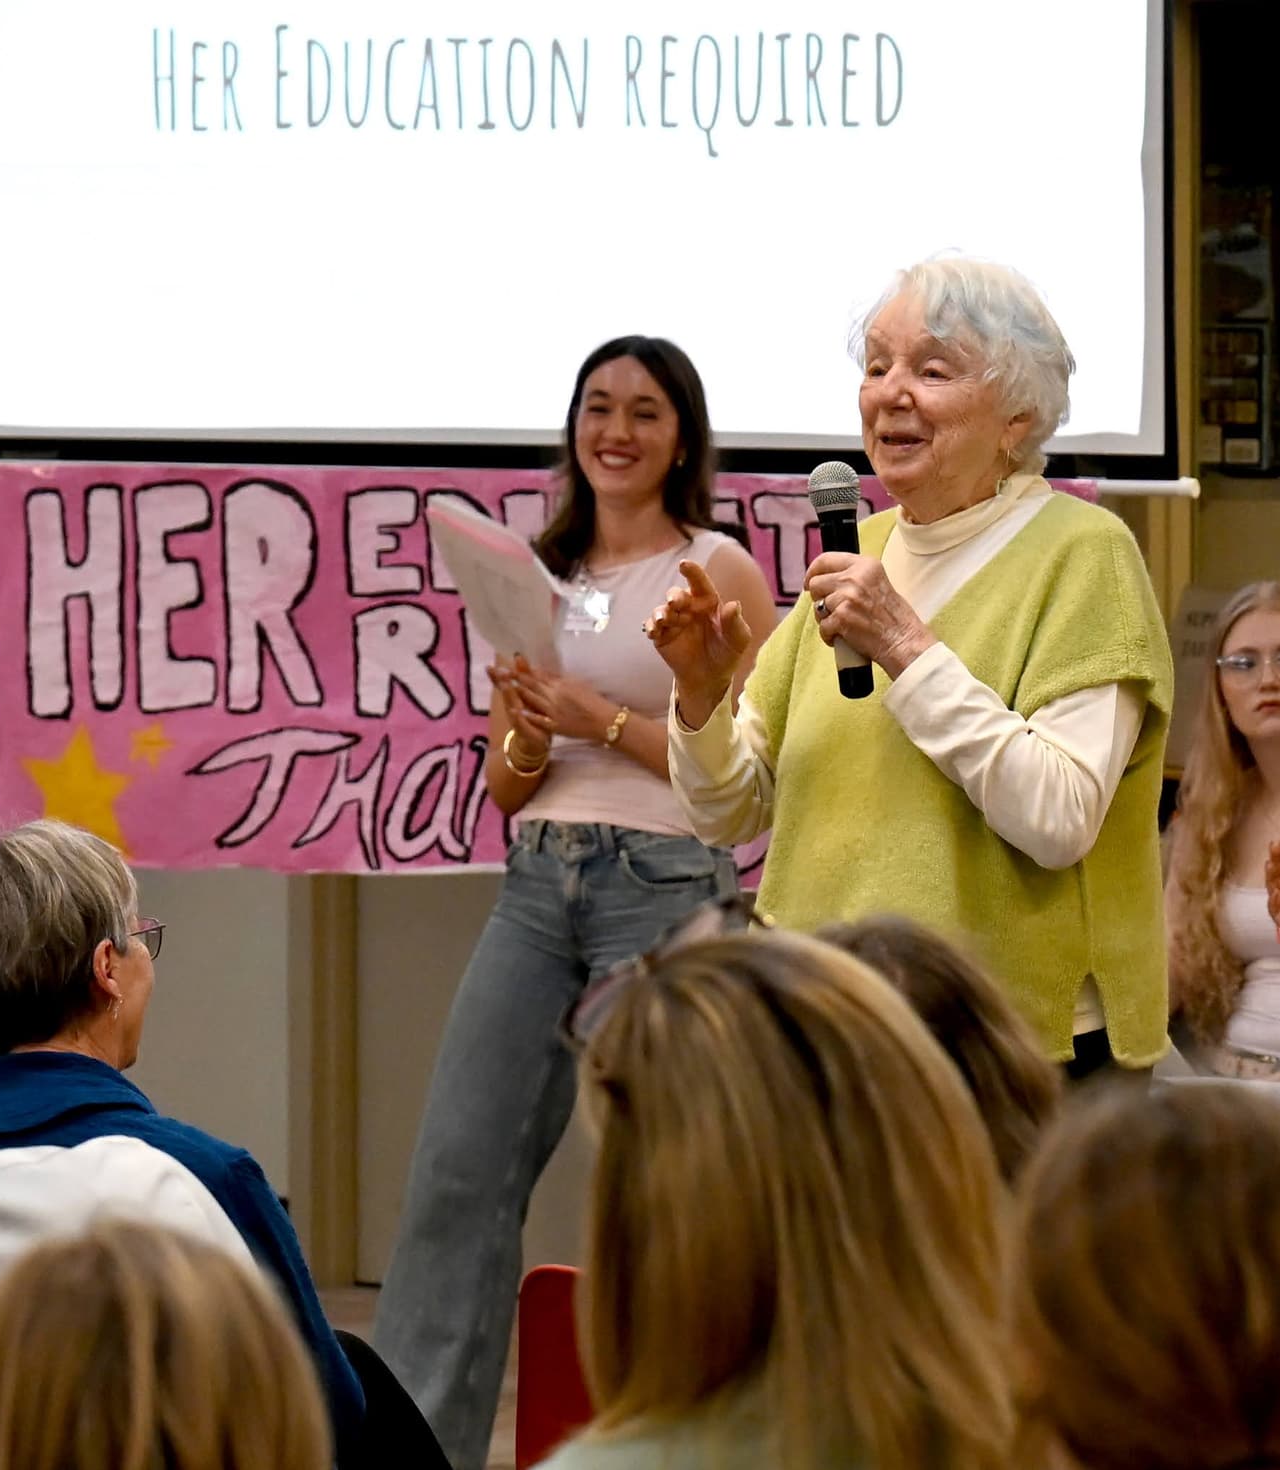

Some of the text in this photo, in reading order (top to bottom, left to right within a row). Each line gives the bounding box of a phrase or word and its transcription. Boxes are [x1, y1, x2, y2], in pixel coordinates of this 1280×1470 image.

[153, 24, 904, 157] HER EDUCATION REQUIRED
[23, 477, 321, 721] HER
